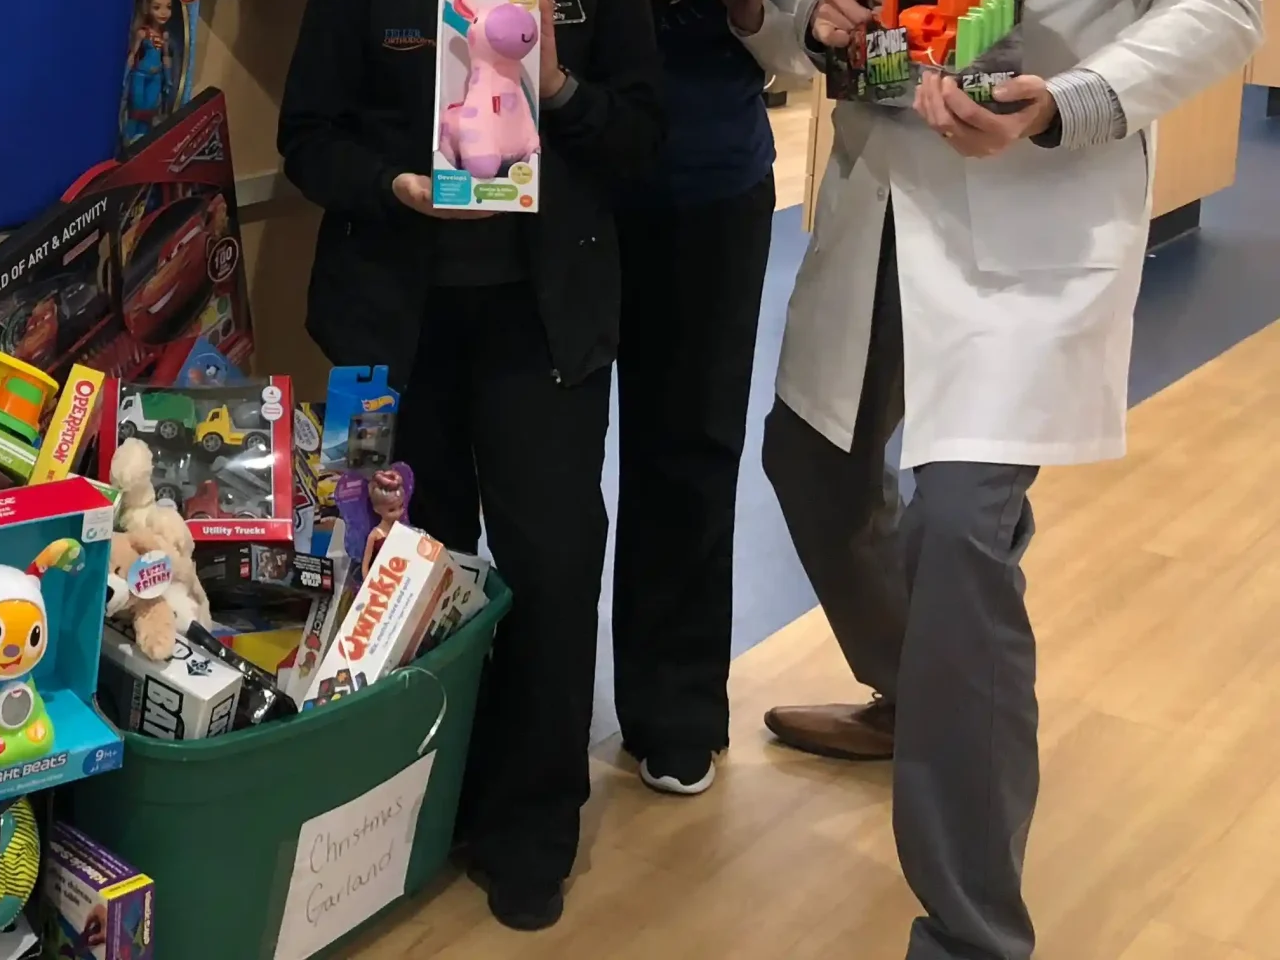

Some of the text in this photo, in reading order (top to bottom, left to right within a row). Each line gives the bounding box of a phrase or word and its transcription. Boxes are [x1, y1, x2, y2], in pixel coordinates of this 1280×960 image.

[866, 27, 908, 59] ZOMBIE
[868, 50, 910, 84] STRIKE
[11, 259, 26, 280] OF
[27, 242, 50, 269] ART
[51, 235, 61, 250] &
[62, 196, 108, 243] ACTIVITY
[53, 380, 95, 464] OPERATION
[202, 525, 266, 537] Utility Trucks
[301, 578, 320, 587] STAR
[337, 555, 410, 662] Qwirkle
[309, 795, 404, 875] Christmas
[306, 837, 395, 928] Garland
